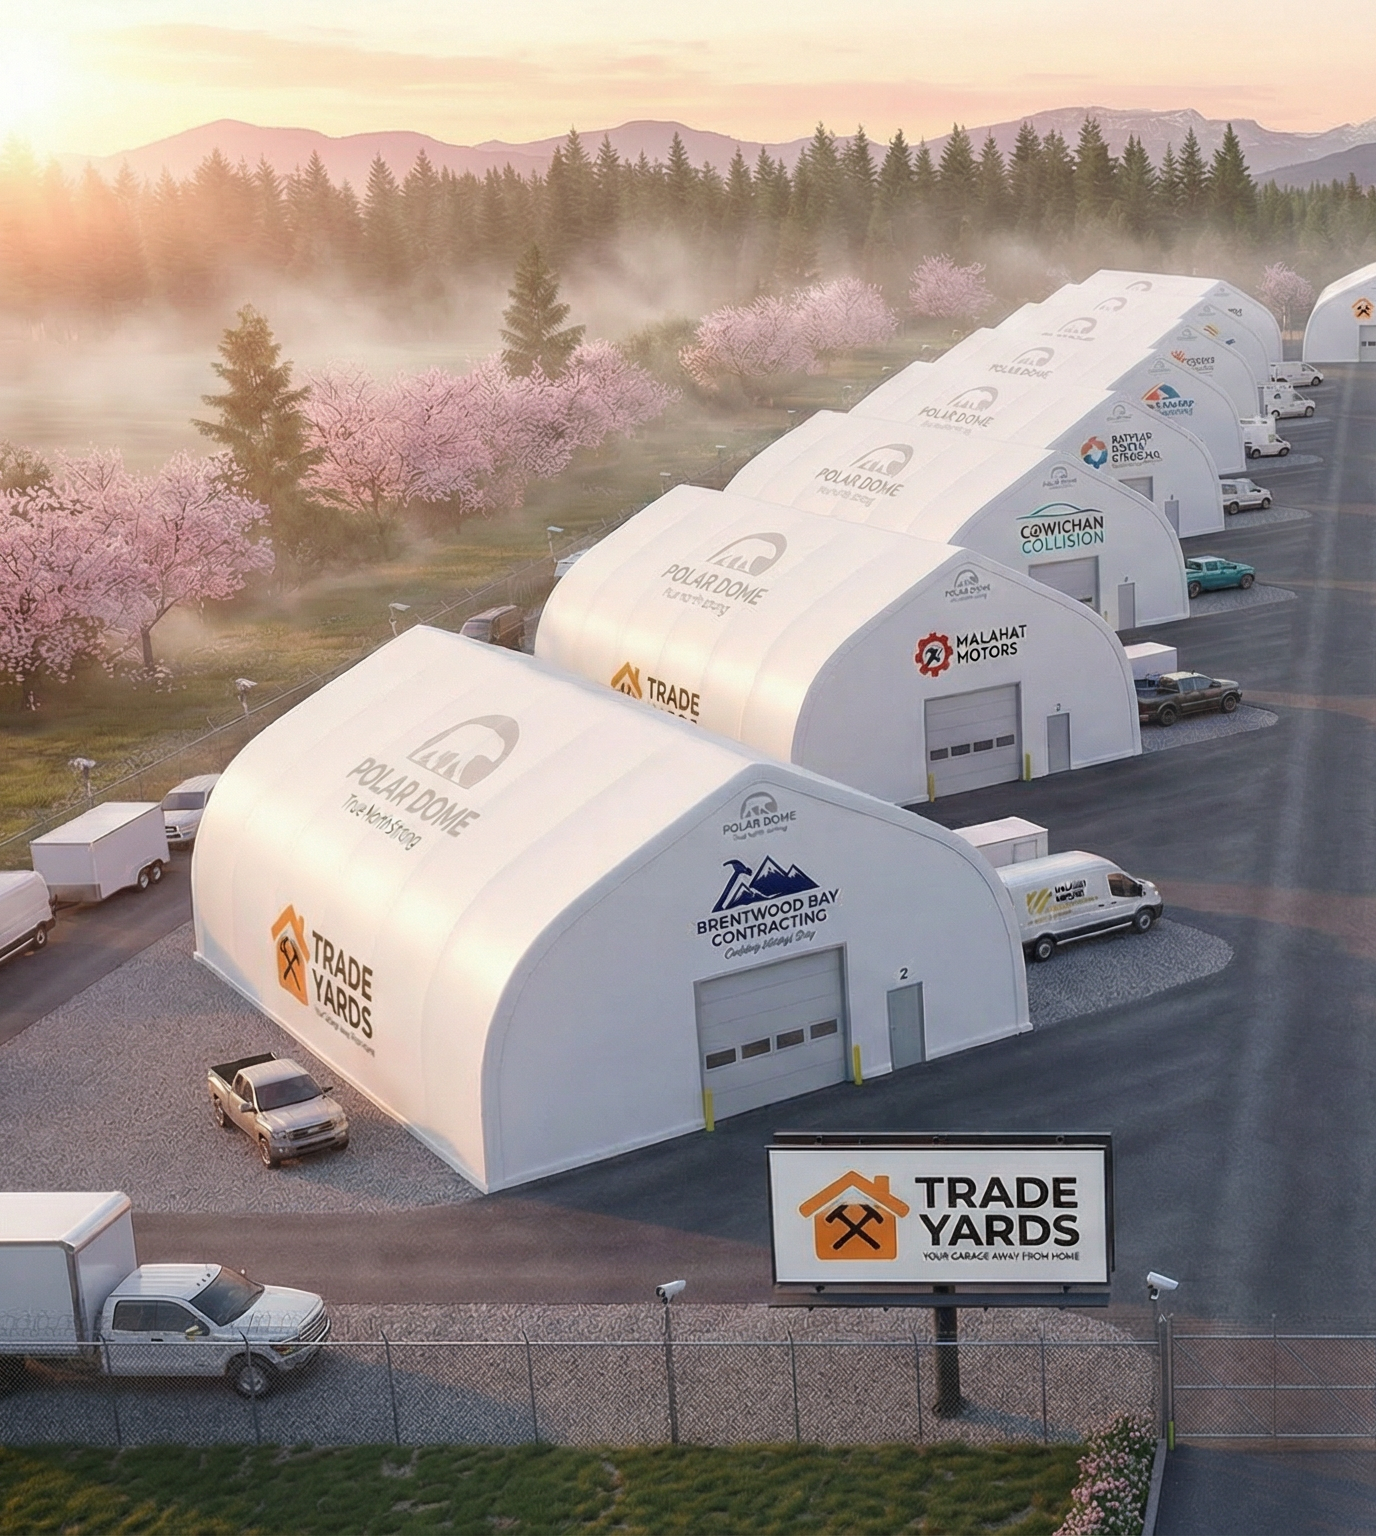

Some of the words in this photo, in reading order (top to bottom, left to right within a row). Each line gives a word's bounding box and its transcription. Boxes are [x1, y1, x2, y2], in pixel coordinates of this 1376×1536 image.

[814, 467, 861, 488] POLAR
[858, 476, 905, 498] DOME
[1022, 530, 1104, 554] COLLISION
[661, 563, 720, 592] POLAR
[713, 577, 769, 606] DOME
[956, 624, 1027, 649] MALAHAT
[957, 642, 1018, 664] MOTORS
[647, 676, 700, 717] TRADE
[346, 757, 420, 807] POLAR
[404, 788, 481, 838] DOME
[722, 818, 761, 836] POLAR
[763, 810, 797, 827] DOME
[696, 898, 804, 935] BRENTWOOD
[808, 888, 840, 909] BAY
[711, 908, 828, 947] CONTRACTING
[312, 929, 373, 1002] TRADE
[899, 967, 909, 981] 2
[312, 967, 373, 1039] YARDS
[914, 1176, 1079, 1209] TRADE
[918, 1213, 1080, 1247] YARDS
[922, 1251, 949, 1261] YOUR
[991, 1251, 1020, 1261] AWAY
[1051, 1251, 1080, 1261] HOME
